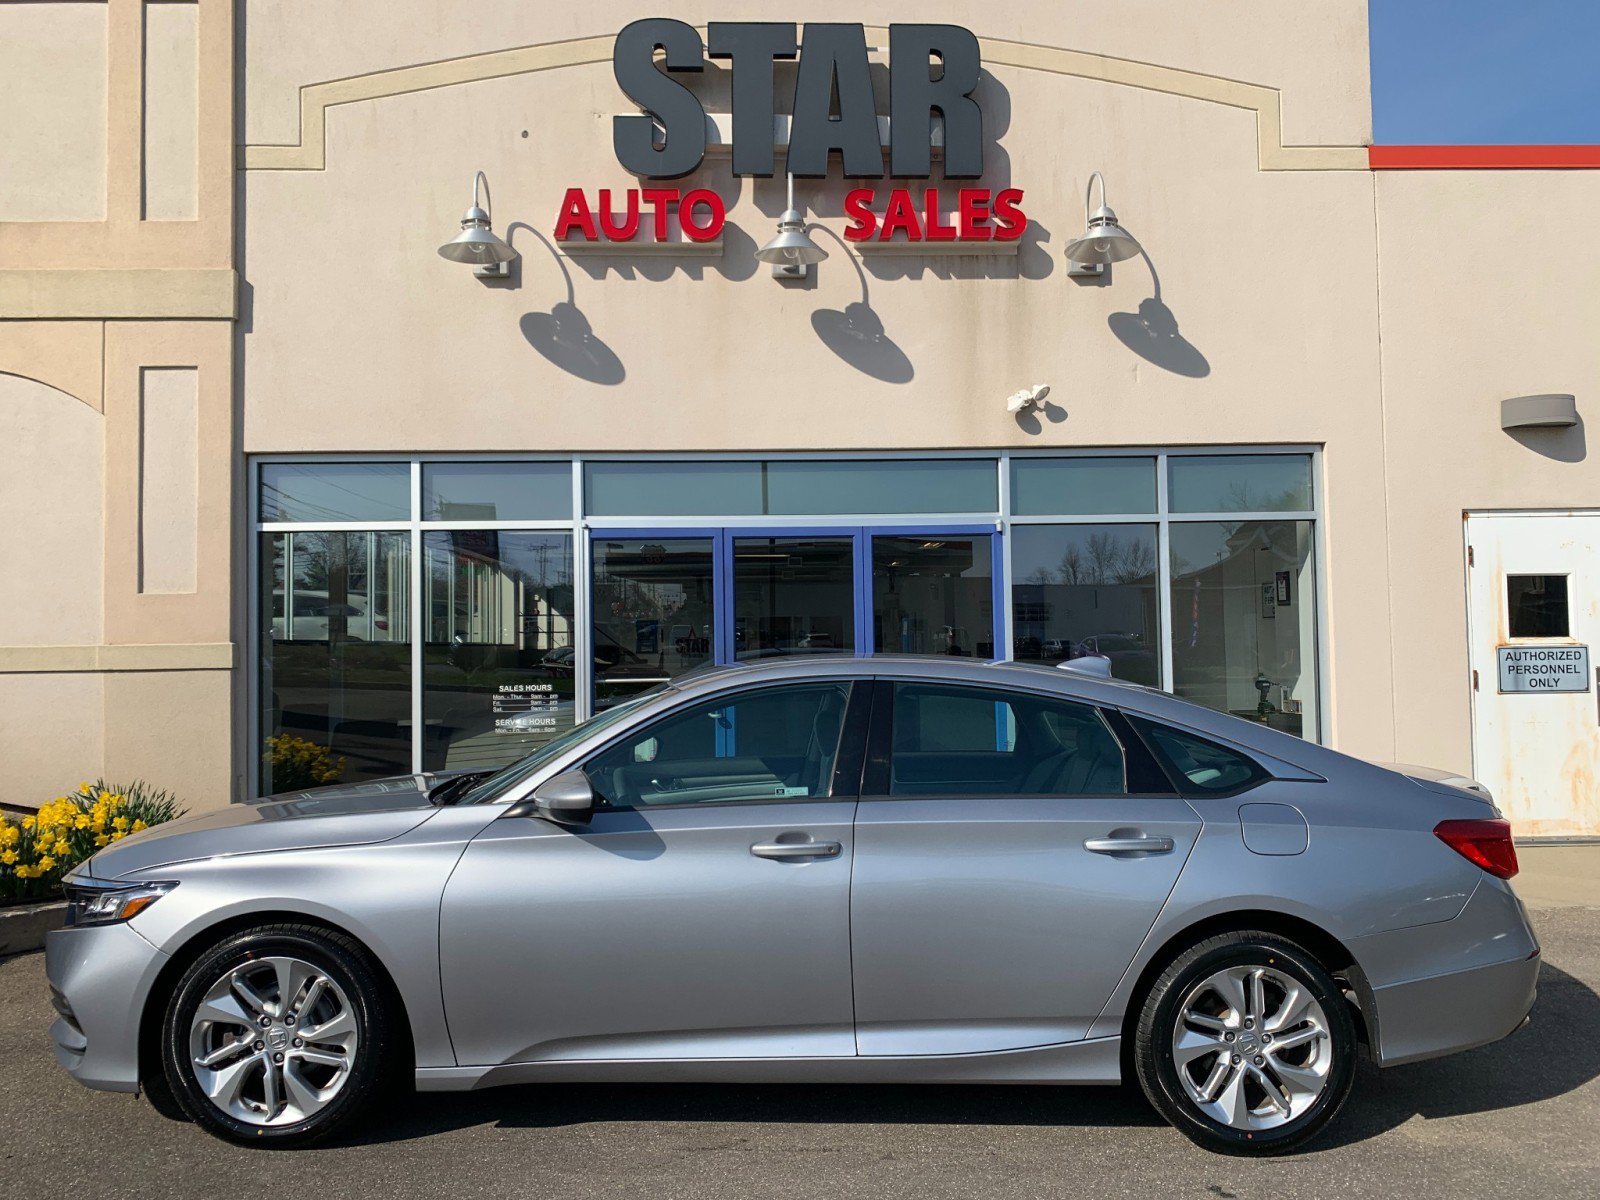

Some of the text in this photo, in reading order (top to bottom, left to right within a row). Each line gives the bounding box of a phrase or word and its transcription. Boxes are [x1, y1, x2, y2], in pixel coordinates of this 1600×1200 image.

[613, 17, 983, 180] STAR
[553, 188, 1027, 242] AUTO SALES
[1505, 651, 1582, 661] AUTHORIZED
[1508, 664, 1581, 674] PERSONNEL
[1529, 678, 1560, 687] ONLY
